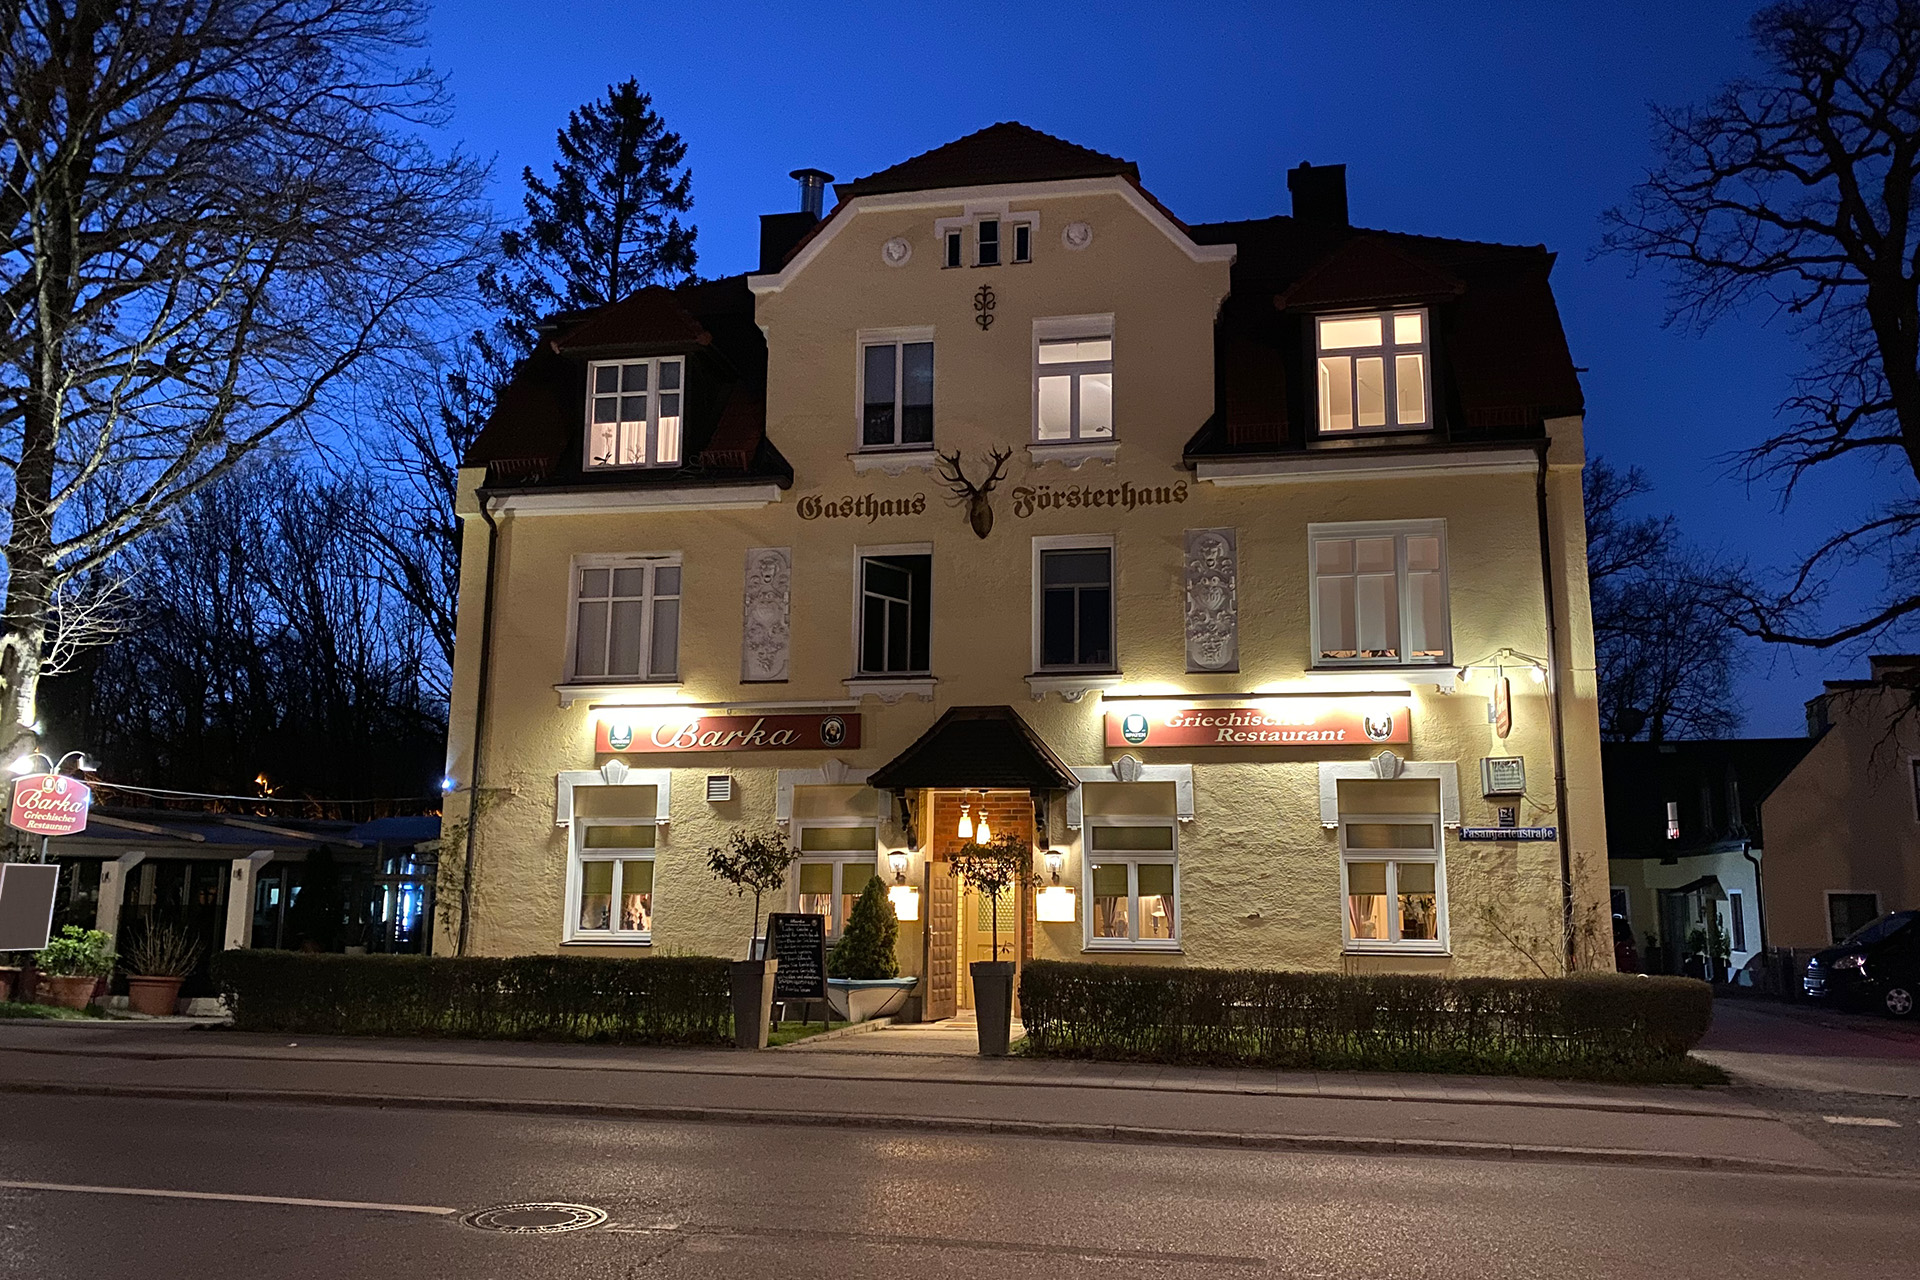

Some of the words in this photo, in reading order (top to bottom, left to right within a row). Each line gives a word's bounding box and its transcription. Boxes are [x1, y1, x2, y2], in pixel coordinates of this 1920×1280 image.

[797, 492, 927, 525] Gasthaus
[1011, 479, 1190, 520] Försterhaus
[650, 717, 802, 749] Barka
[1215, 728, 1347, 742] Restaurant
[17, 788, 84, 813] Barka
[24, 811, 76, 823] Griechisches
[27, 820, 72, 831] Restaurant
[1463, 827, 1553, 840] Fasangartenstraße
